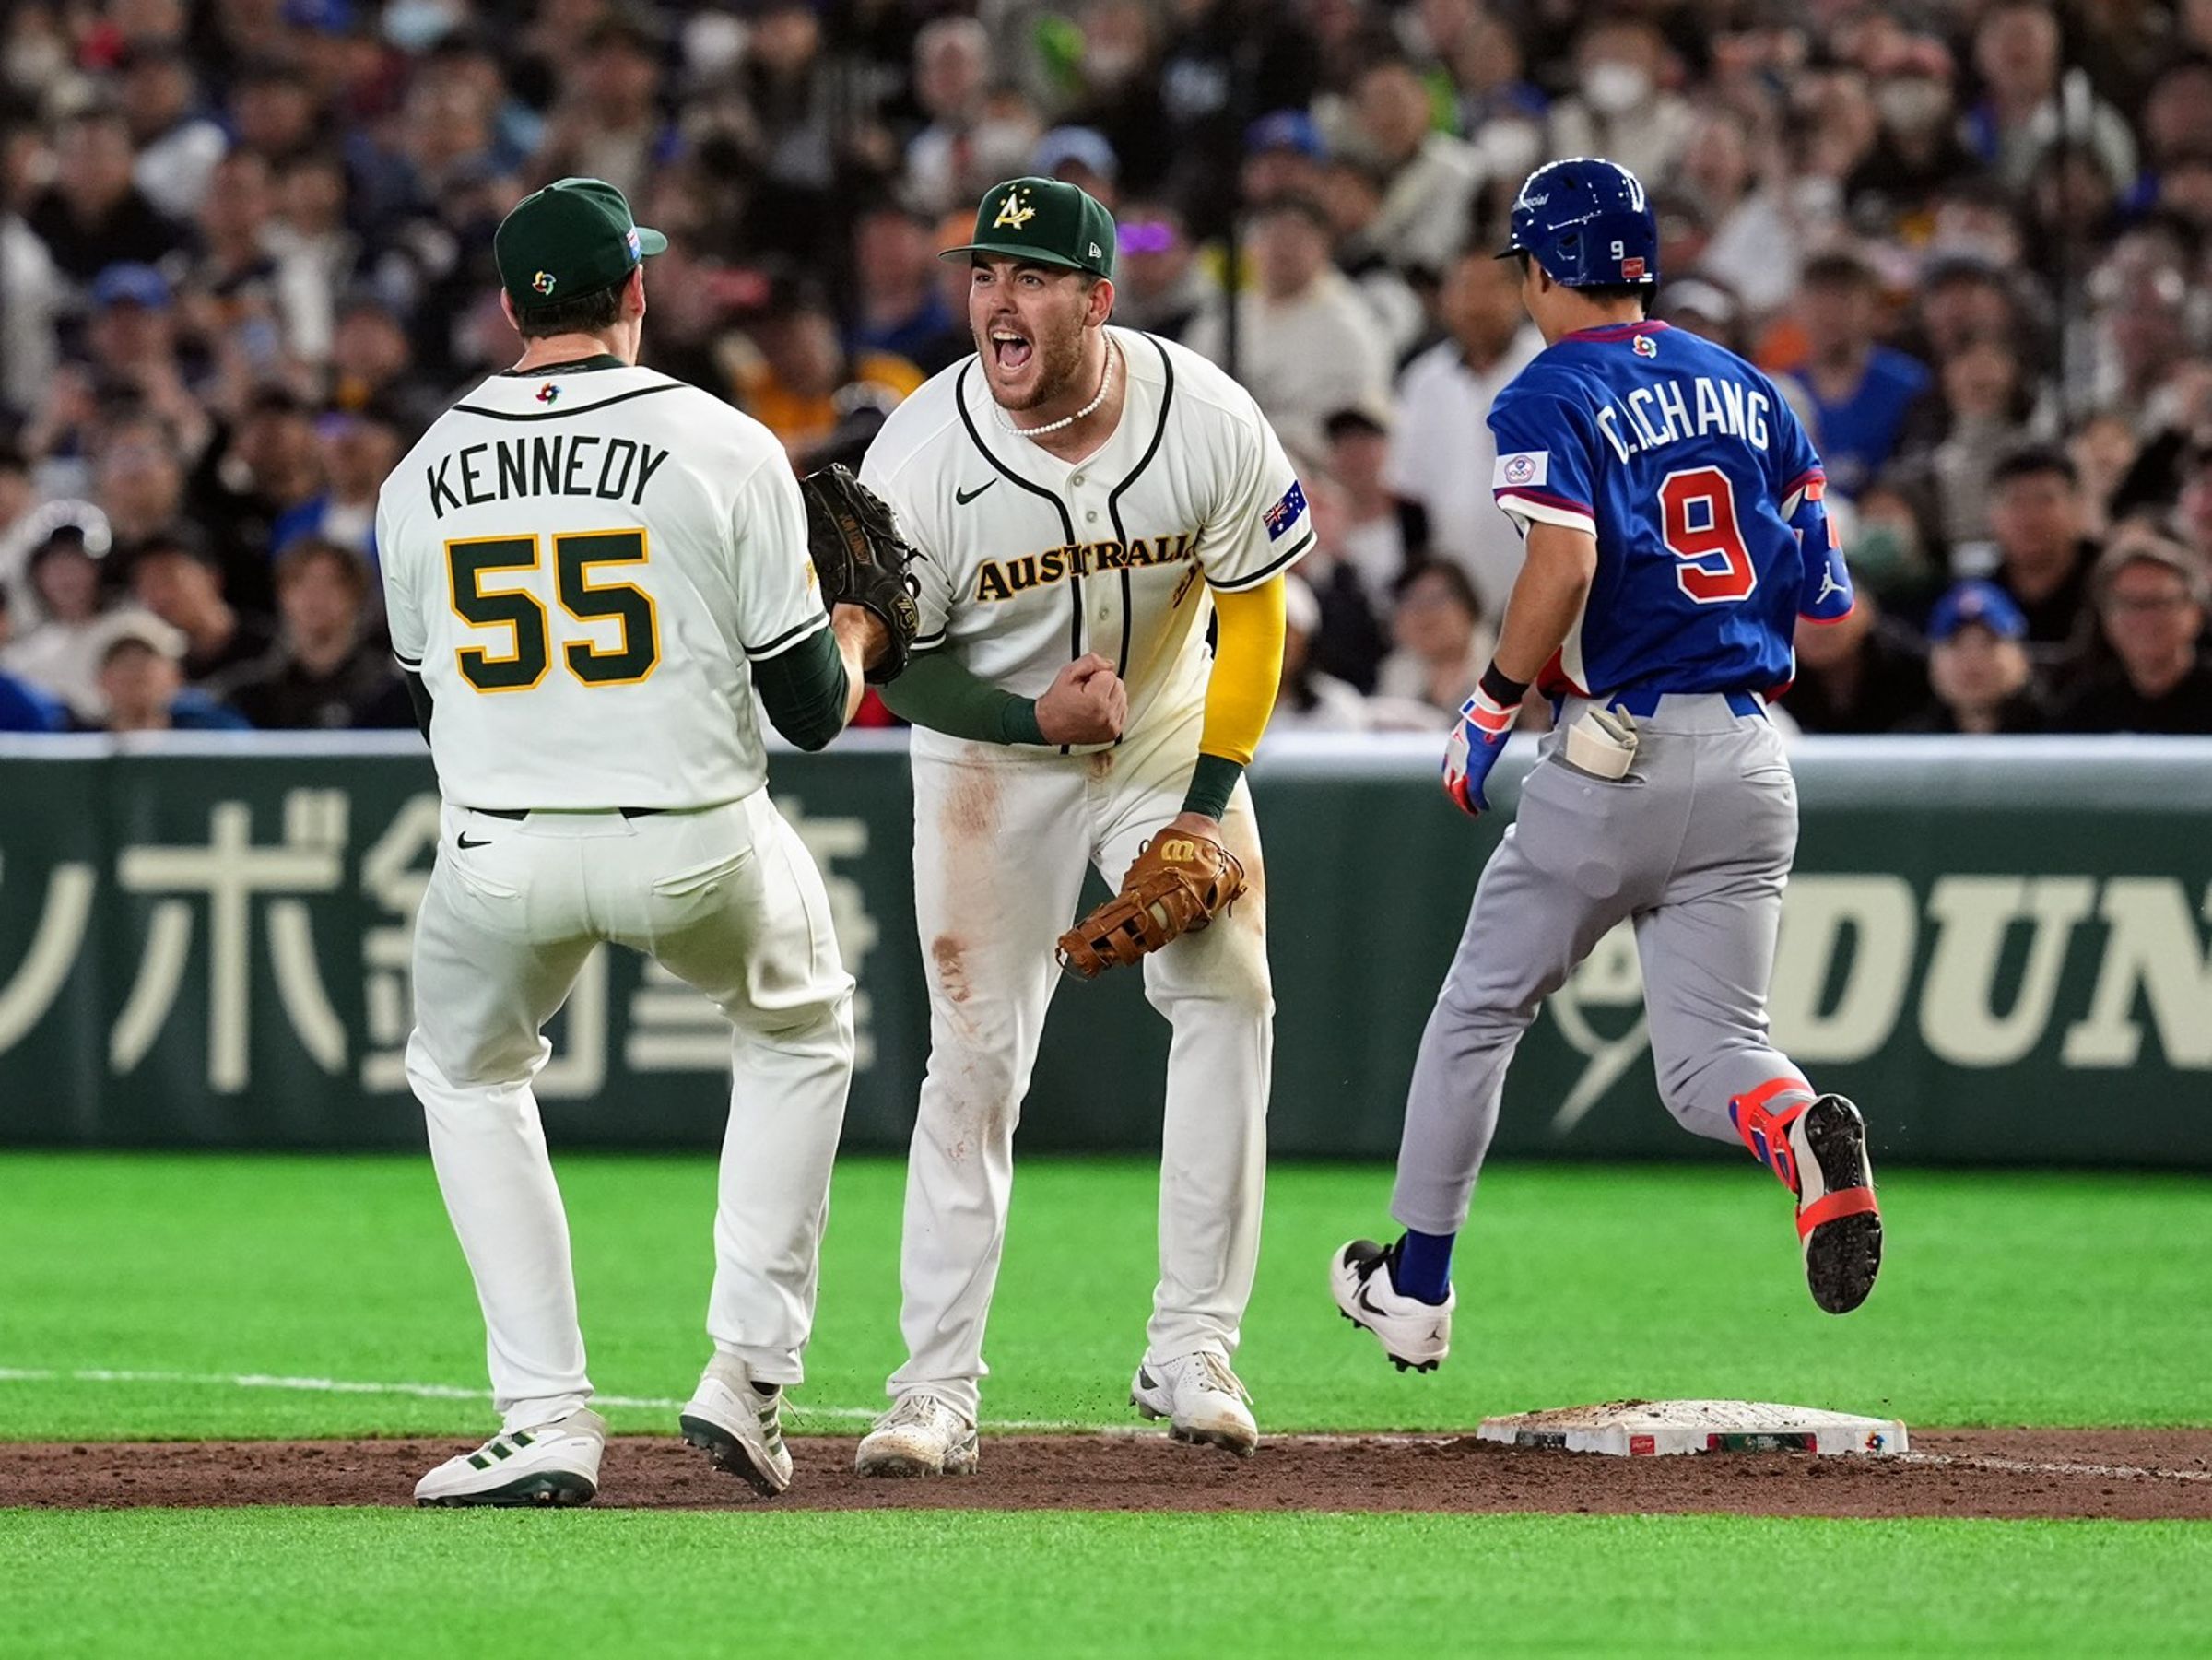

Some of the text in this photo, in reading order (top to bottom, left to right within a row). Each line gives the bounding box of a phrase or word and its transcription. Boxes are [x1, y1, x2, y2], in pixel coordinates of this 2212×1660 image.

[1610, 240, 1624, 260] 9
[426, 435, 670, 520] KENNEDY
[976, 534, 1197, 603] AUSTRALI
[1657, 465, 1758, 605] 9
[443, 527, 662, 694] 55
